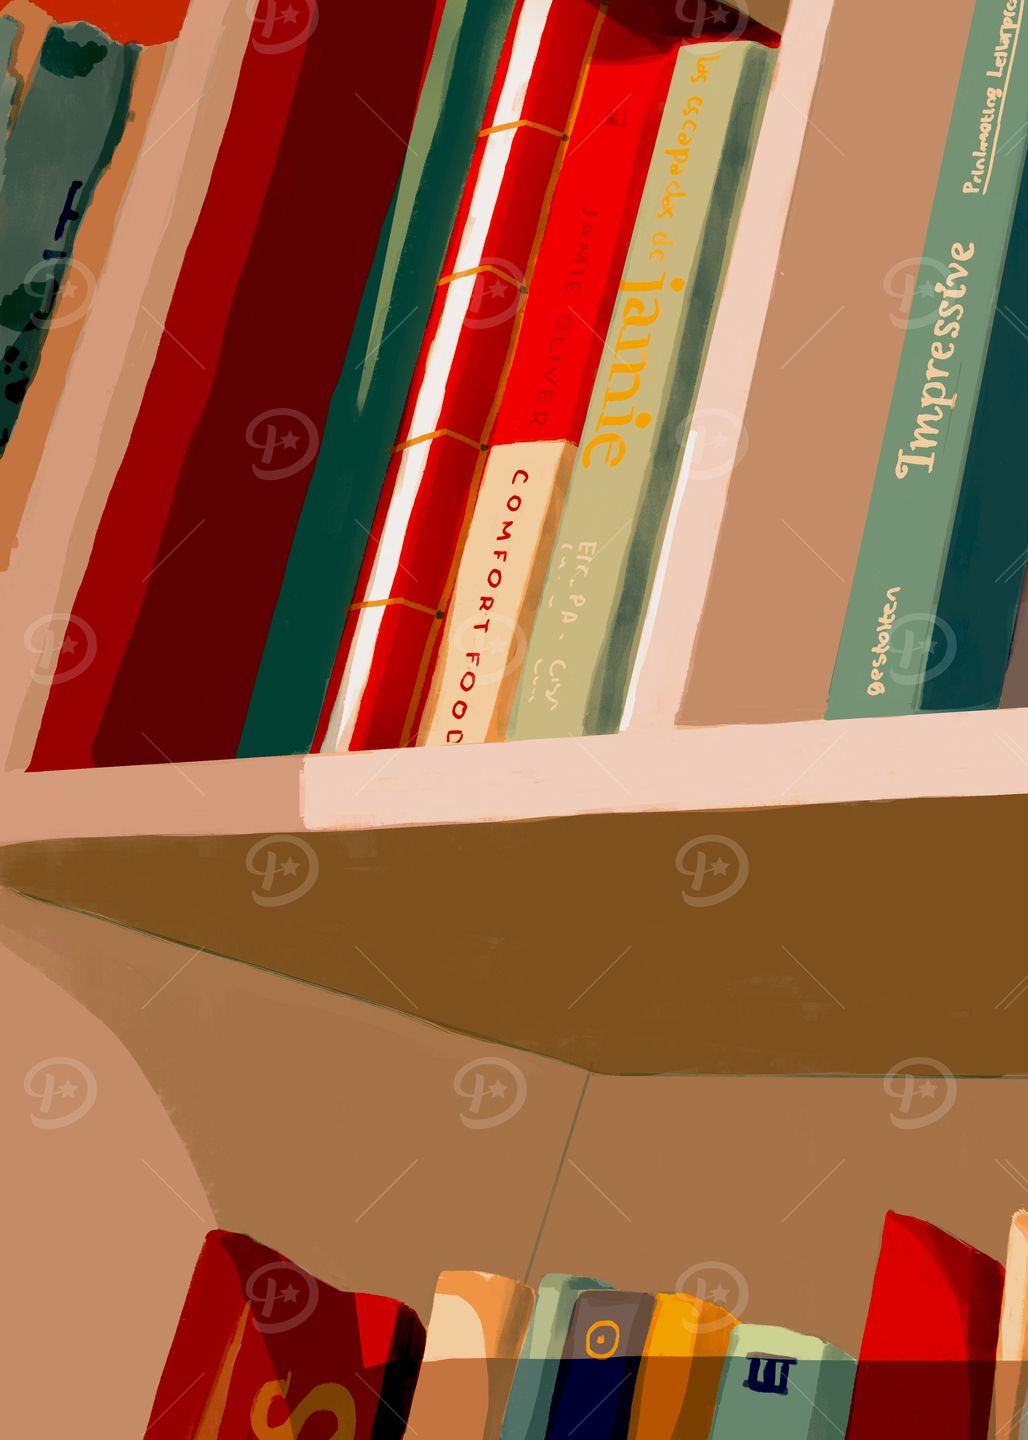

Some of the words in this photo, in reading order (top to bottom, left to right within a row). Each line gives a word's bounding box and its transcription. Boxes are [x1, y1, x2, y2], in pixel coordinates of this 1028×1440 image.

[564, 204, 599, 296] JAMIE
[649, 230, 675, 262] de
[529, 313, 573, 428] OLIVER
[581, 271, 686, 471] jamie
[894, 239, 976, 481] Impressive
[473, 468, 530, 635] COMFORT
